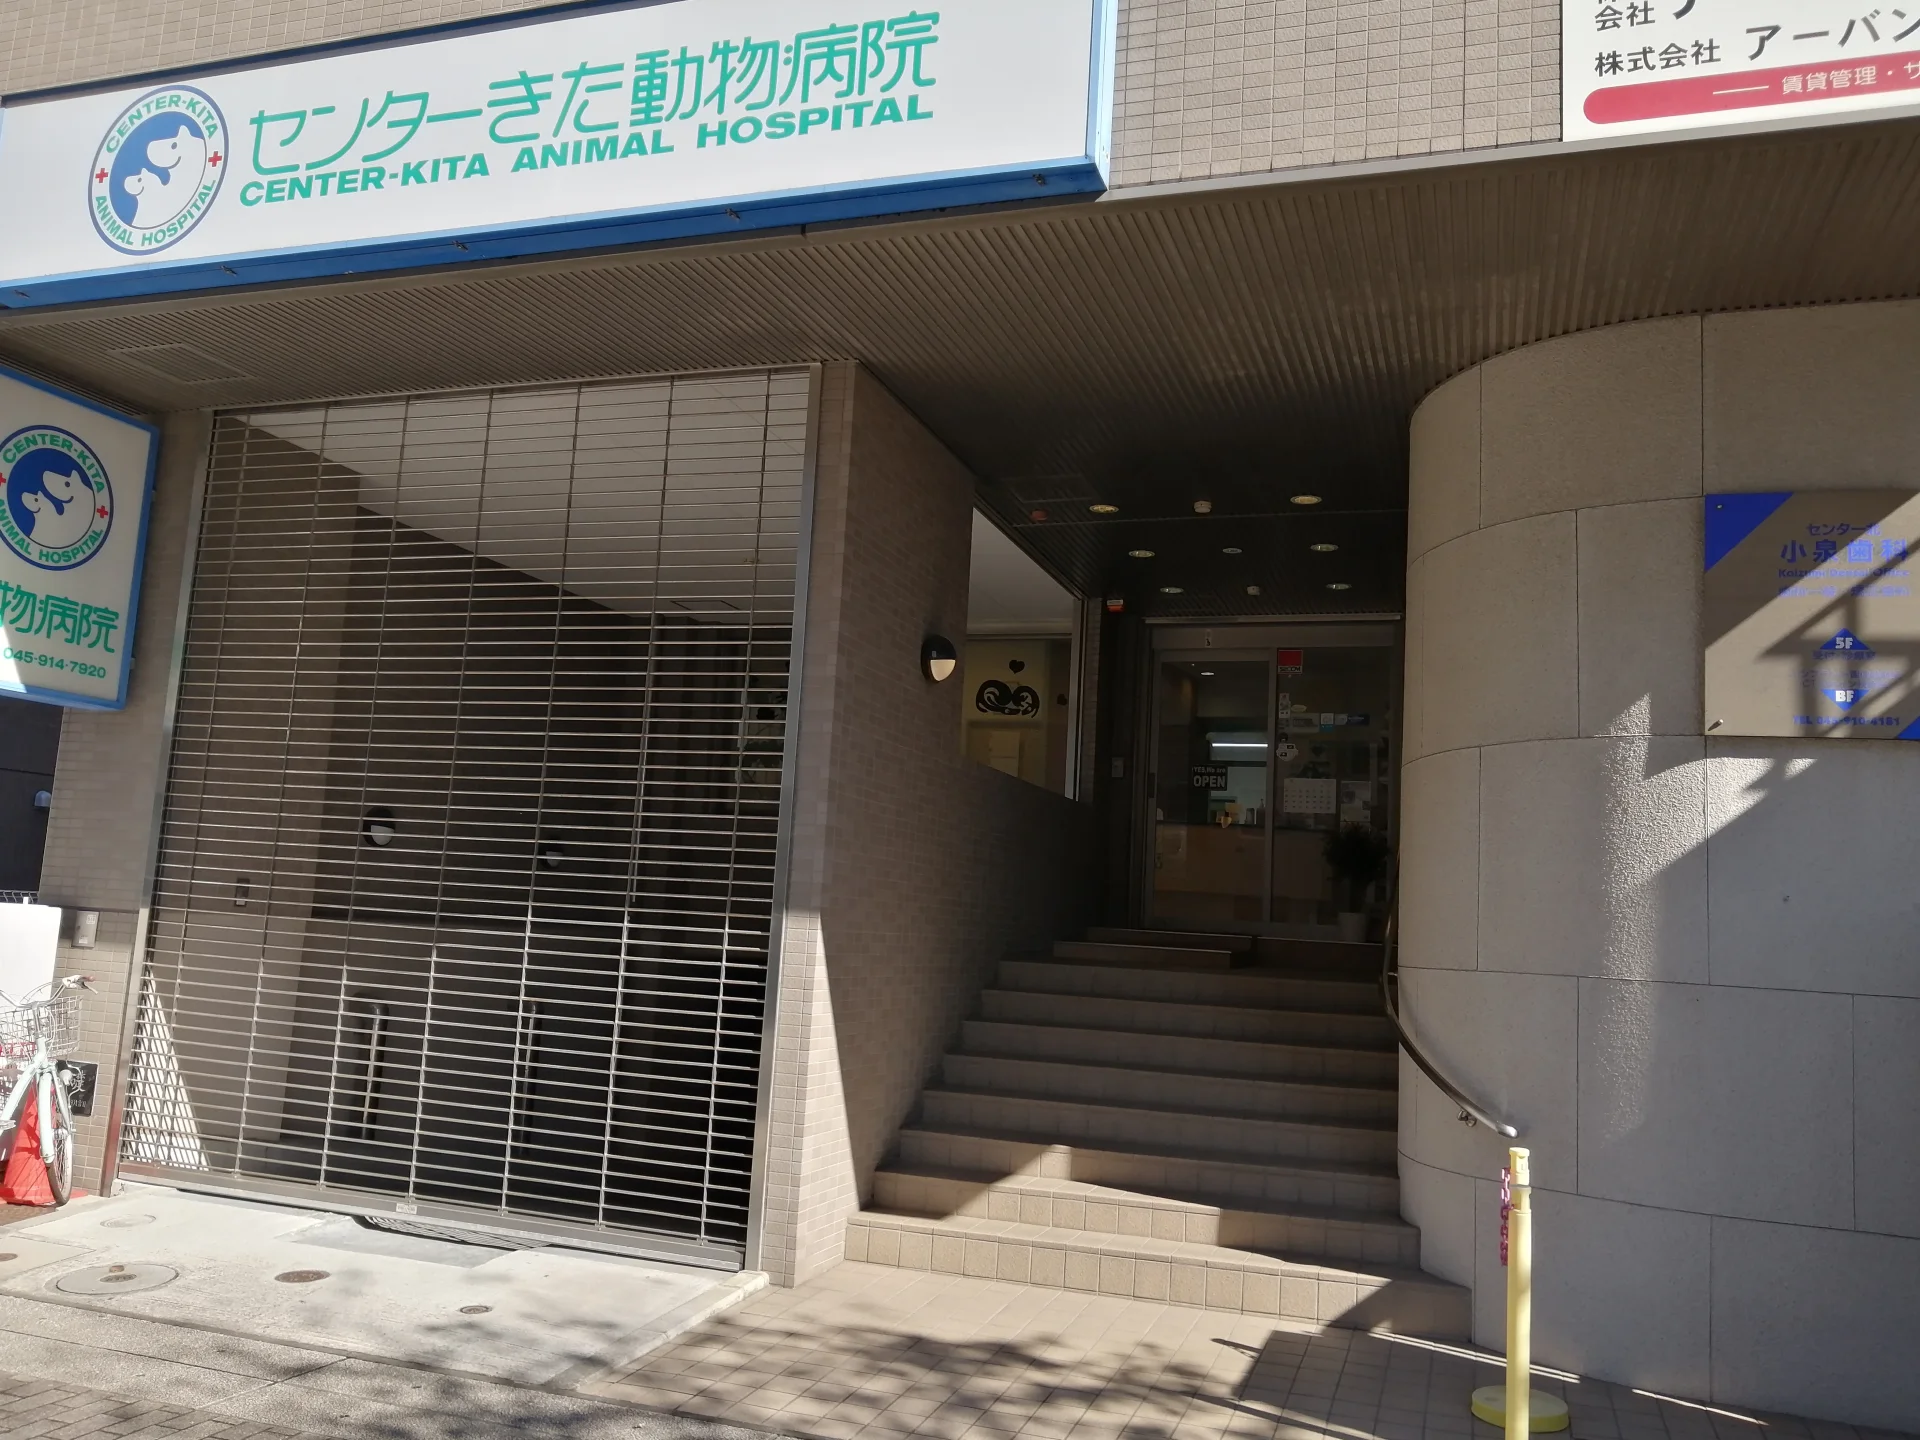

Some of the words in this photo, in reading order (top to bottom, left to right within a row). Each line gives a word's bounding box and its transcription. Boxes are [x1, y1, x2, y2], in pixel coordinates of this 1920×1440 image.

[1594, 37, 1722, 77] 株式会社
[1745, 8, 1920, 61] アーバン
[249, 10, 940, 176] センターきた動物病院
[105, 93, 220, 155] CENTER-KITA
[240, 153, 490, 207] CENTER-KITA
[511, 129, 675, 173] ANIMAL
[696, 93, 934, 149] HOSPITAL
[95, 194, 135, 247] ANIMAL
[140, 178, 217, 248] HOSPITAL
[2, 433, 106, 494] CENTER-KITA
[39, 528, 104, 564] HOSPITAL
[1780, 539, 1909, 563] 小泉歯科
[0, 580, 119, 653] 物病院
[1835, 637, 1854, 650] 5F
[1835, 690, 1854, 702] BF
[1193, 775, 1226, 788] OPEN
